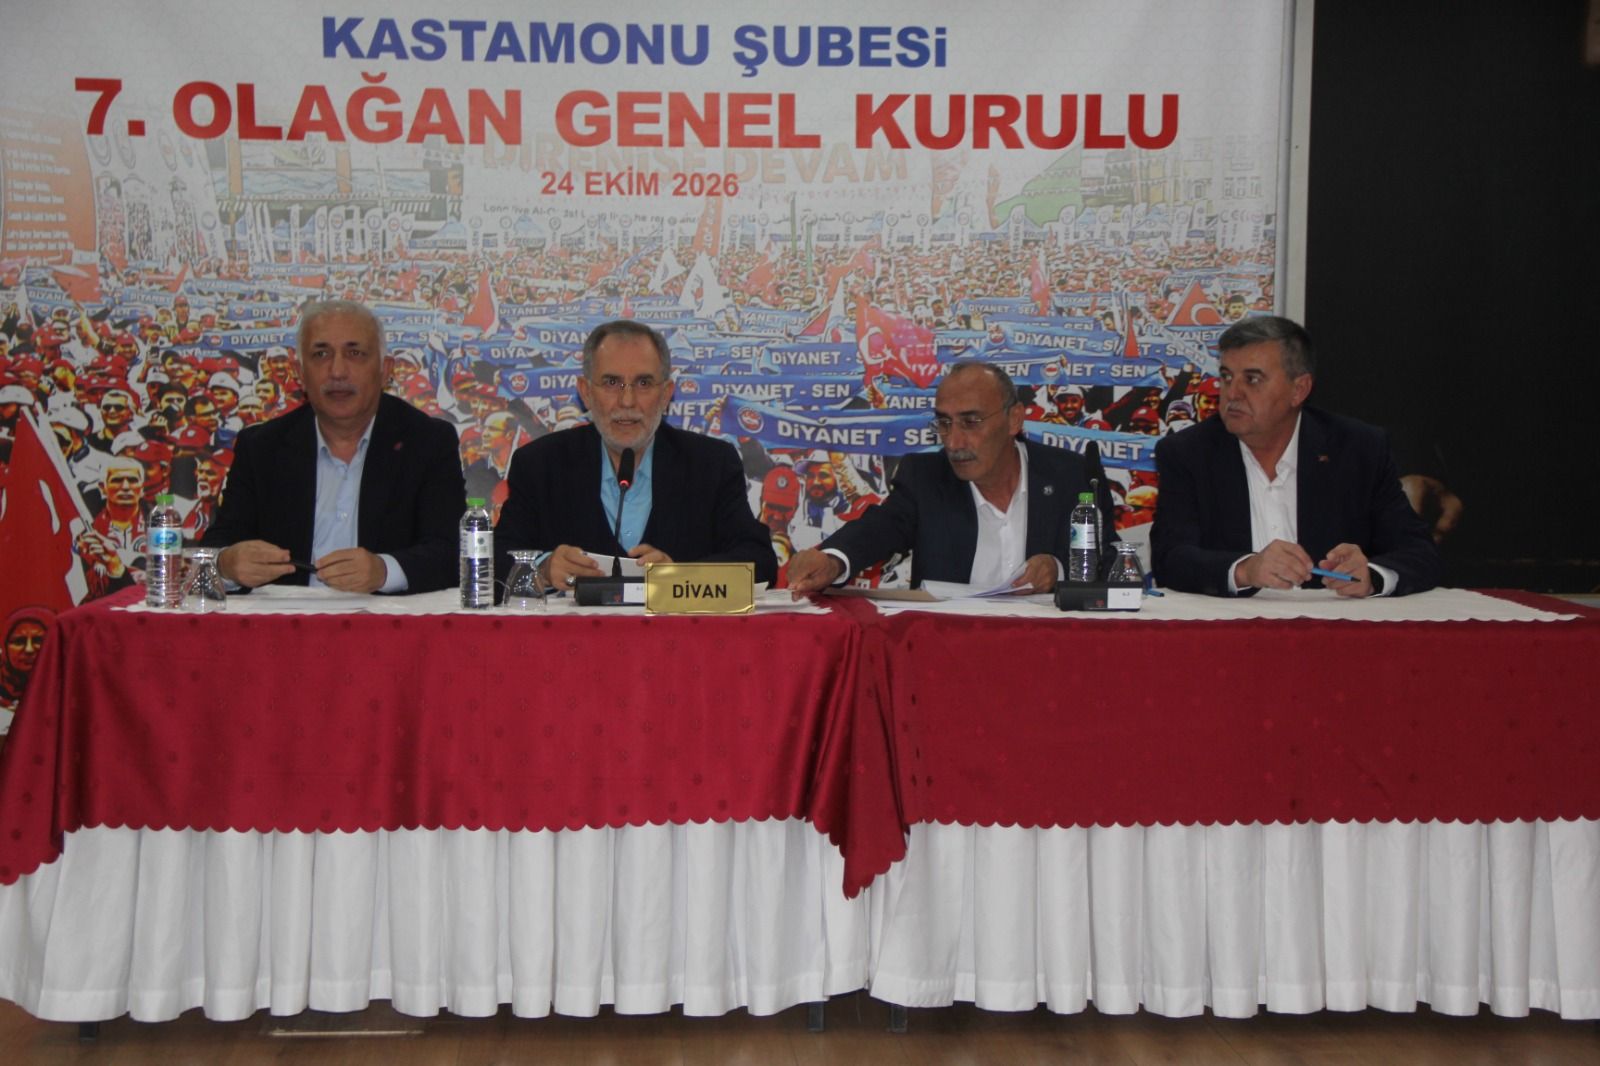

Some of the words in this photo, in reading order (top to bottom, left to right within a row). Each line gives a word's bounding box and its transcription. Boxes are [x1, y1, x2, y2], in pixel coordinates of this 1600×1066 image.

[324, 18, 708, 65] KASTAMONU
[76, 78, 145, 136] 7.
[174, 72, 520, 144] OLAĞAN
[557, 92, 820, 148] GENEL
[856, 95, 1178, 150] KURULU
[541, 173, 573, 195] 24
[585, 167, 658, 196] EKİM
[673, 174, 738, 196] 2026
[1110, 364, 1147, 378] SEN
[811, 383, 850, 398] SEN
[673, 580, 727, 599] DİVAN
